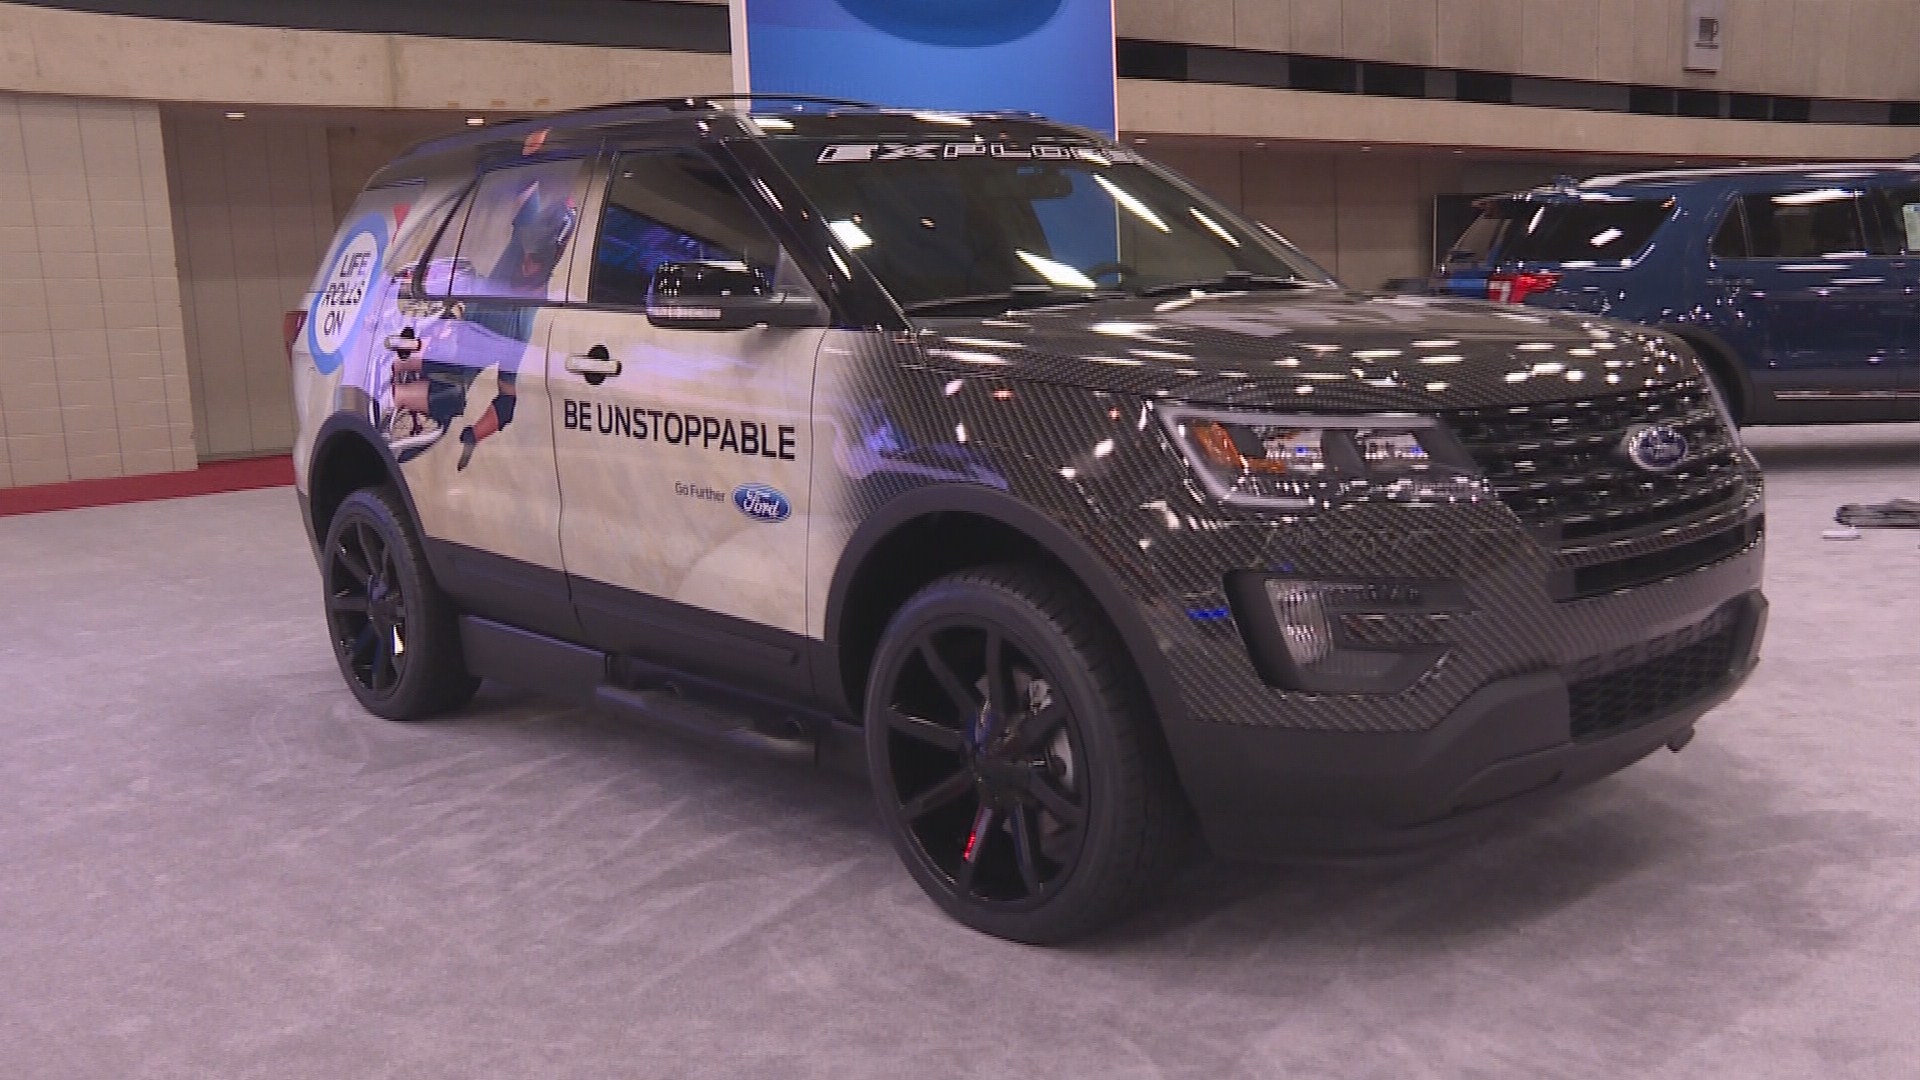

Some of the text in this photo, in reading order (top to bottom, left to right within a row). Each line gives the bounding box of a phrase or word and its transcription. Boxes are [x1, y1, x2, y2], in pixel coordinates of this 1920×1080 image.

[340, 252, 371, 277] LIFE
[321, 282, 365, 306] ROLLS
[323, 310, 346, 335] ON
[563, 399, 592, 432] BE
[597, 403, 796, 461] UNSTOPPABLE
[674, 480, 726, 503] Go Further
[743, 490, 780, 517] Ford
